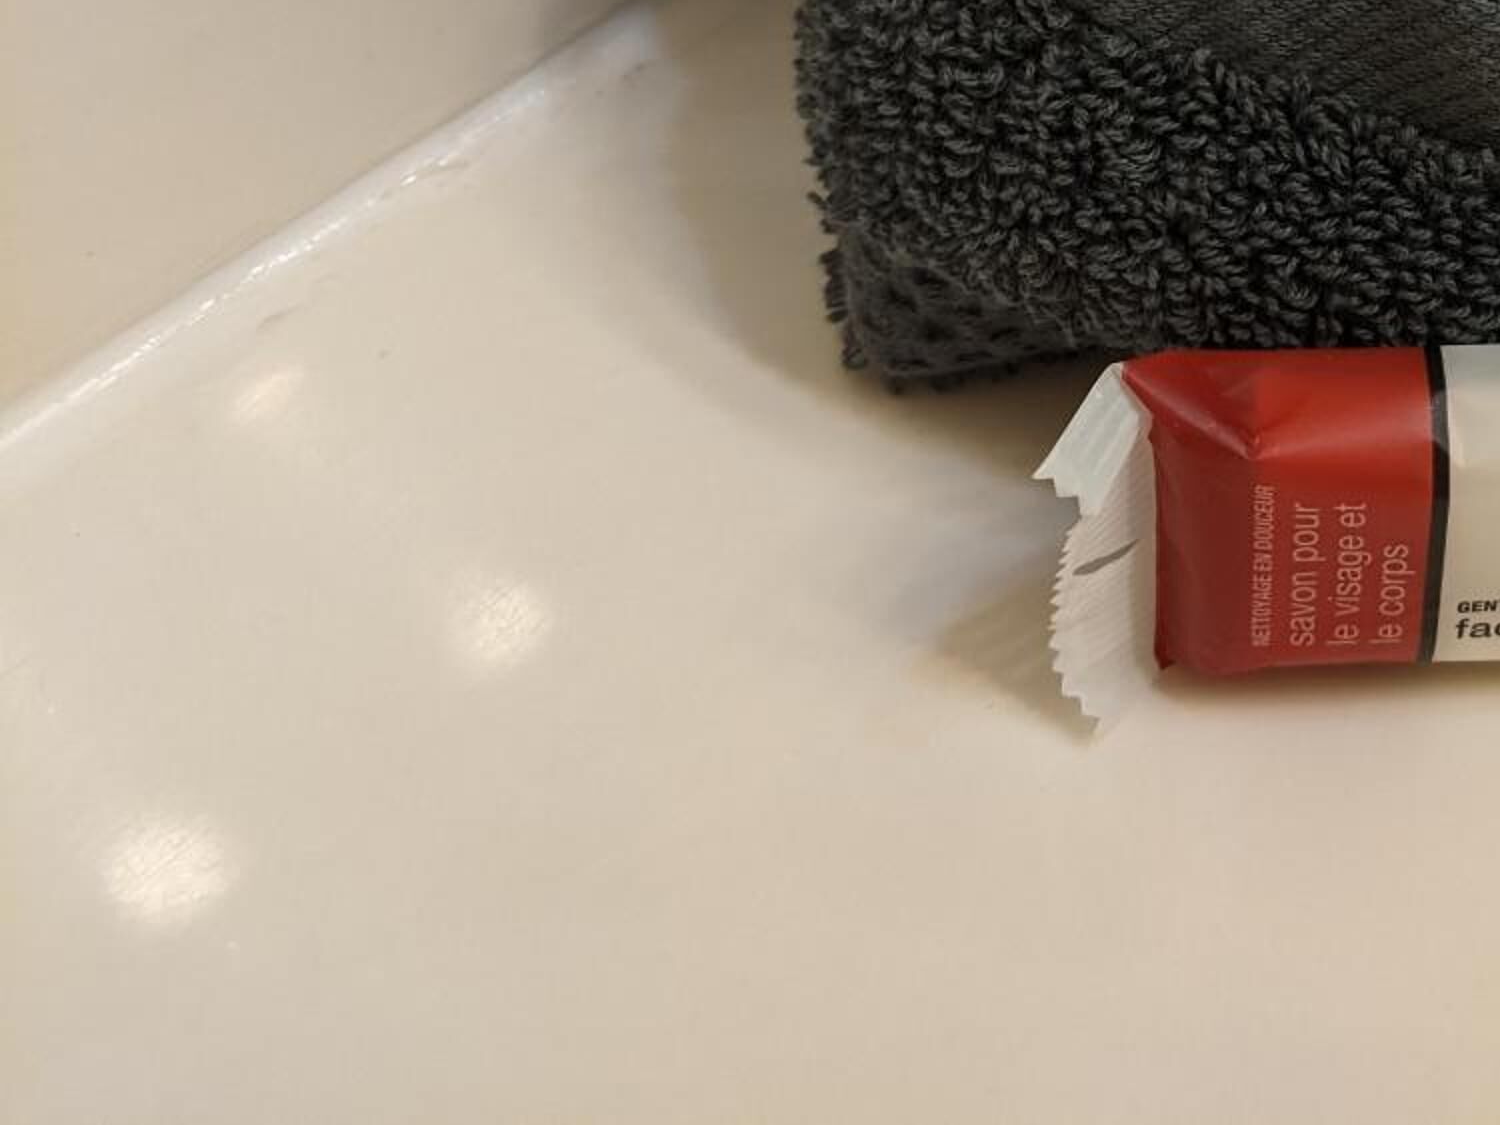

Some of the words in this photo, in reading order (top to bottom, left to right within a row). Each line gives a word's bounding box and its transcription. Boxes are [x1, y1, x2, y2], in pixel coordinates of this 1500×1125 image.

[1252, 484, 1277, 550] DOUCEUR
[1293, 503, 1326, 562] pour
[1334, 503, 1367, 527] et
[1328, 535, 1372, 617] visage
[1378, 543, 1416, 616] corps
[1290, 571, 1317, 646] savon
[1325, 625, 1359, 646] le
[1368, 624, 1403, 644] le
